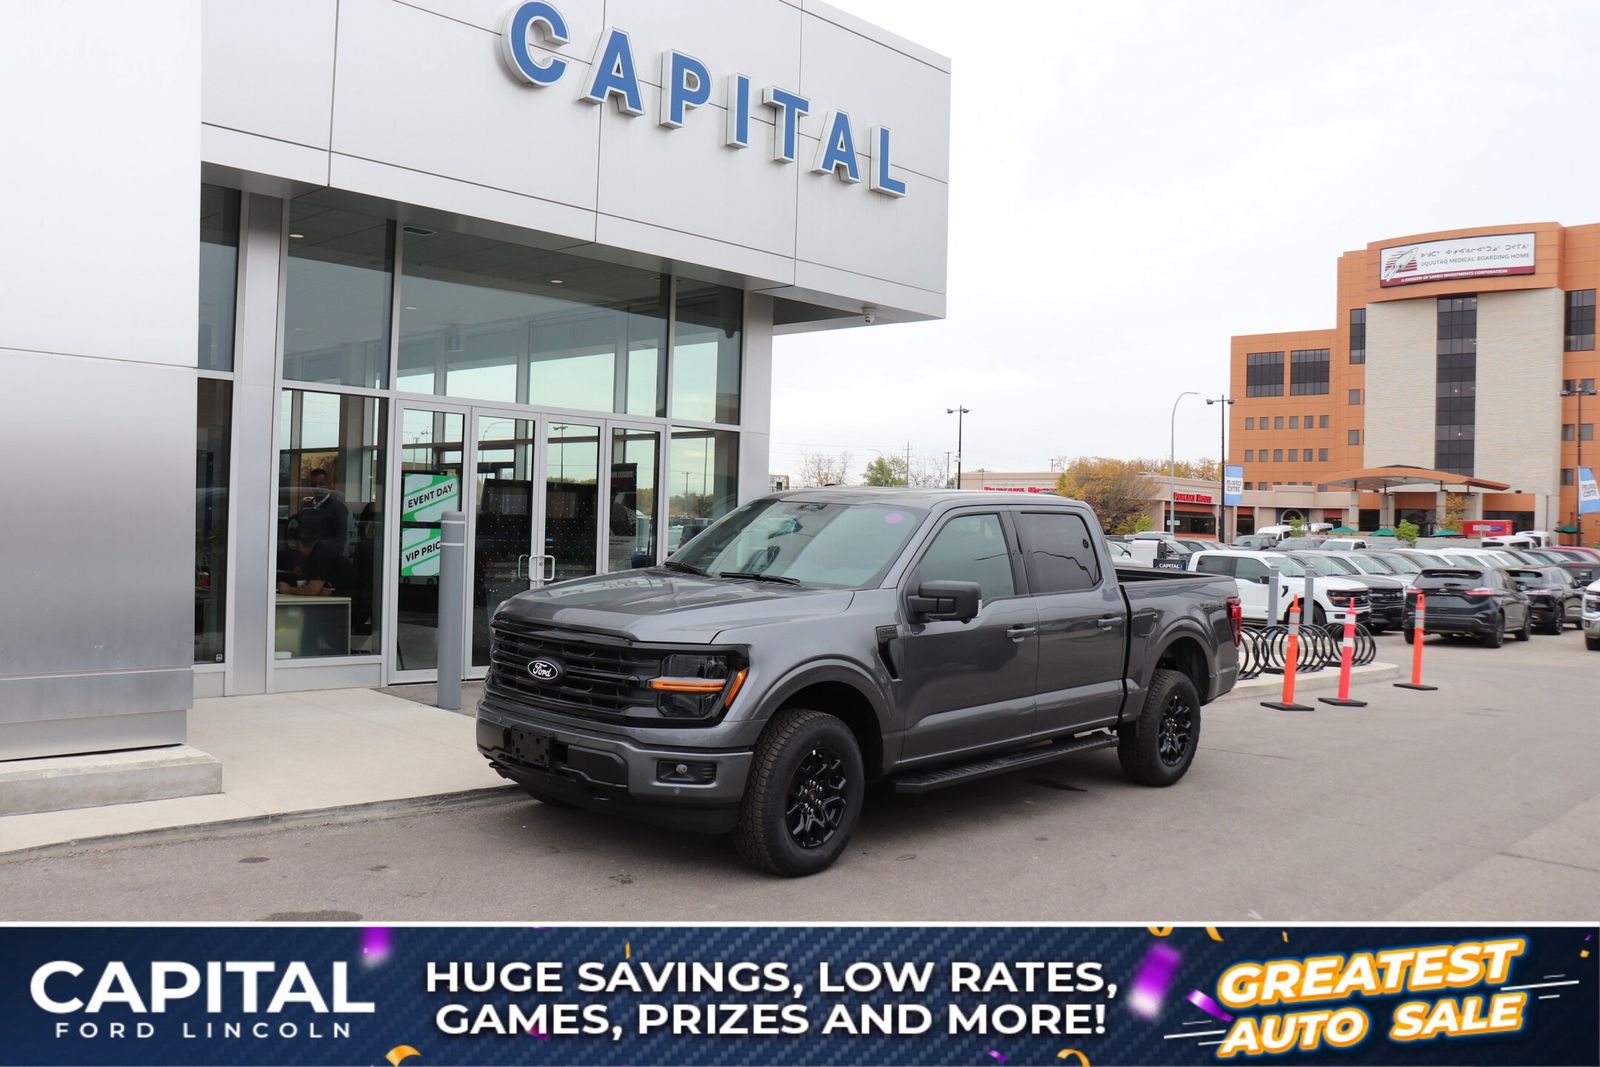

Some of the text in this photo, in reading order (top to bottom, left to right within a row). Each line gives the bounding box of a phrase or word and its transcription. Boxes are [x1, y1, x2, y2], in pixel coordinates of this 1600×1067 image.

[502, 0, 907, 198] CAPITAL
[1449, 256, 1475, 265] MEDICAL
[1476, 253, 1510, 262] BOARDING
[1510, 251, 1531, 259] HOME
[408, 483, 454, 508] EVENT DAY
[405, 550, 420, 562] VIP
[1158, 562, 1181, 570] CAPITAL
[531, 662, 553, 678] Ford
